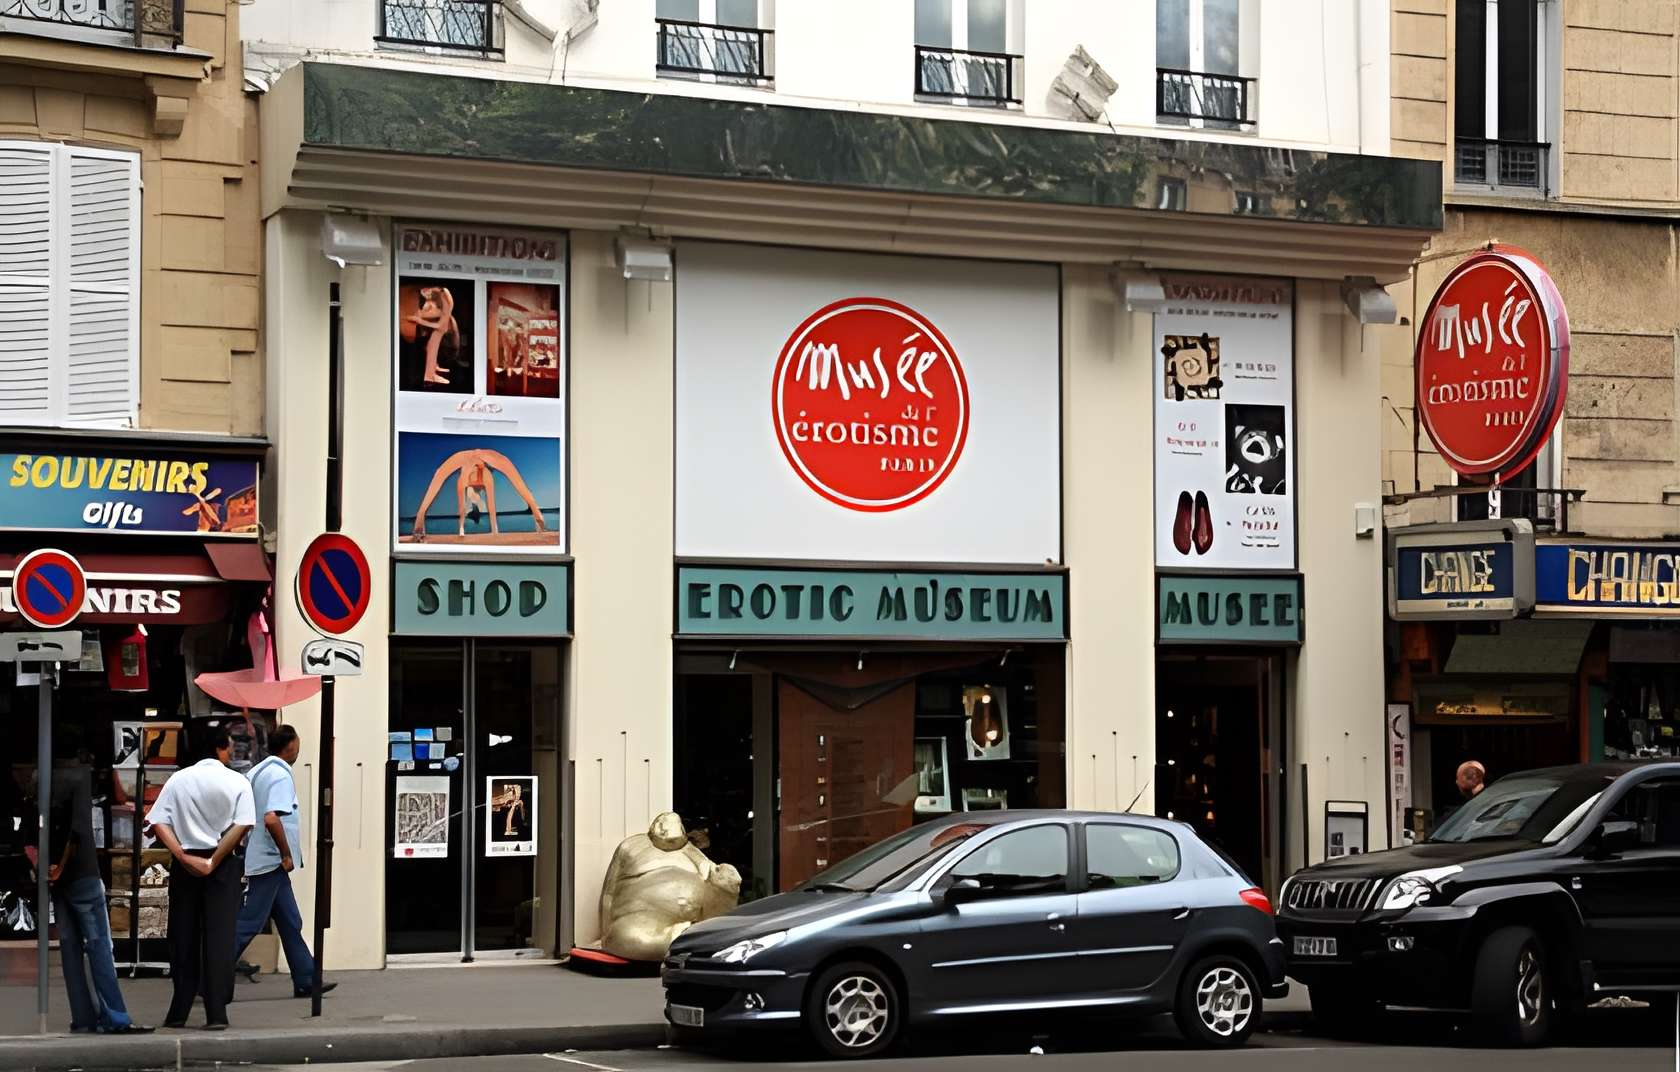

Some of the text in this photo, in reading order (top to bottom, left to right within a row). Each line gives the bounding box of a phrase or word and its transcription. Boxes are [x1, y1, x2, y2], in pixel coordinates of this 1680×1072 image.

[1431, 280, 1531, 359] Musée
[795, 332, 938, 401] Musée
[9, 455, 209, 494] SOUVENIRS
[687, 578, 1053, 623] EROTIC MUSEUM
[1567, 548, 1680, 605] CHANG
[1162, 590, 1295, 627] MUSEE
